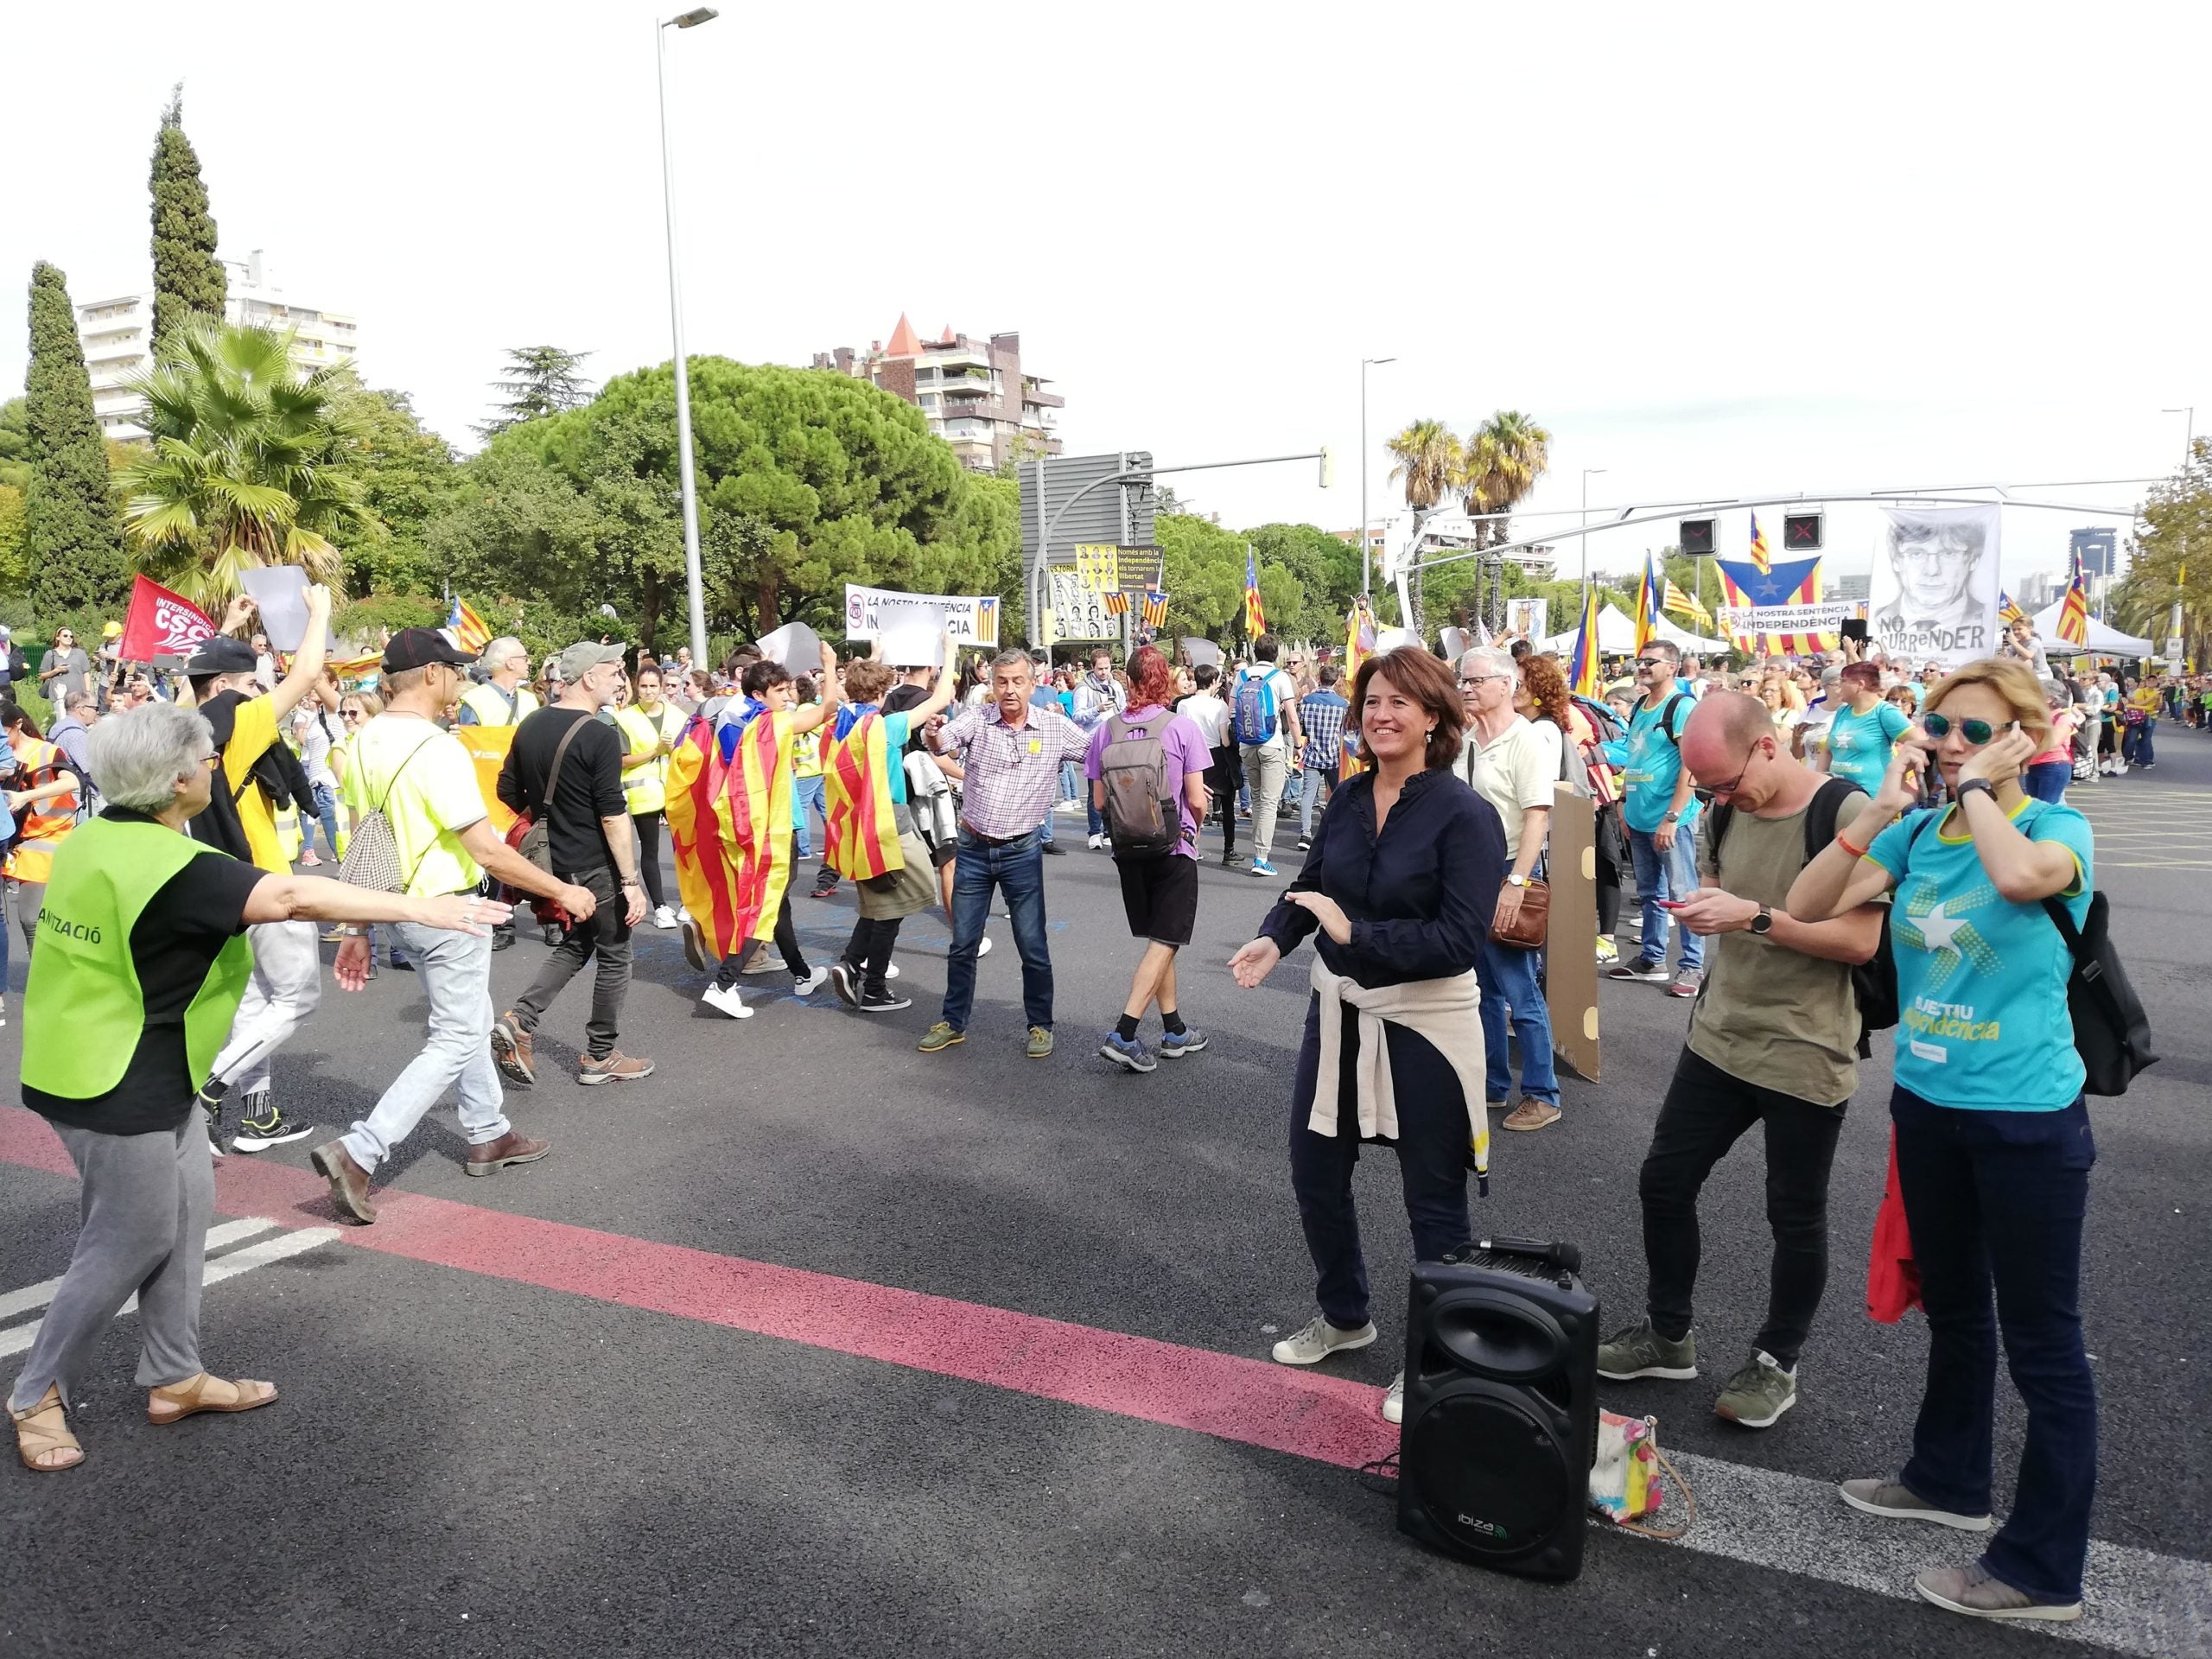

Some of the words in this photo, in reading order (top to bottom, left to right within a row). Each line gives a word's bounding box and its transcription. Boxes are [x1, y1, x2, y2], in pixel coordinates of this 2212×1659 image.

[868, 595, 879, 607] LA
[1796, 605, 1851, 616] SENTÈNCIA
[156, 607, 211, 642] CSC
[1879, 614, 1905, 634] NO
